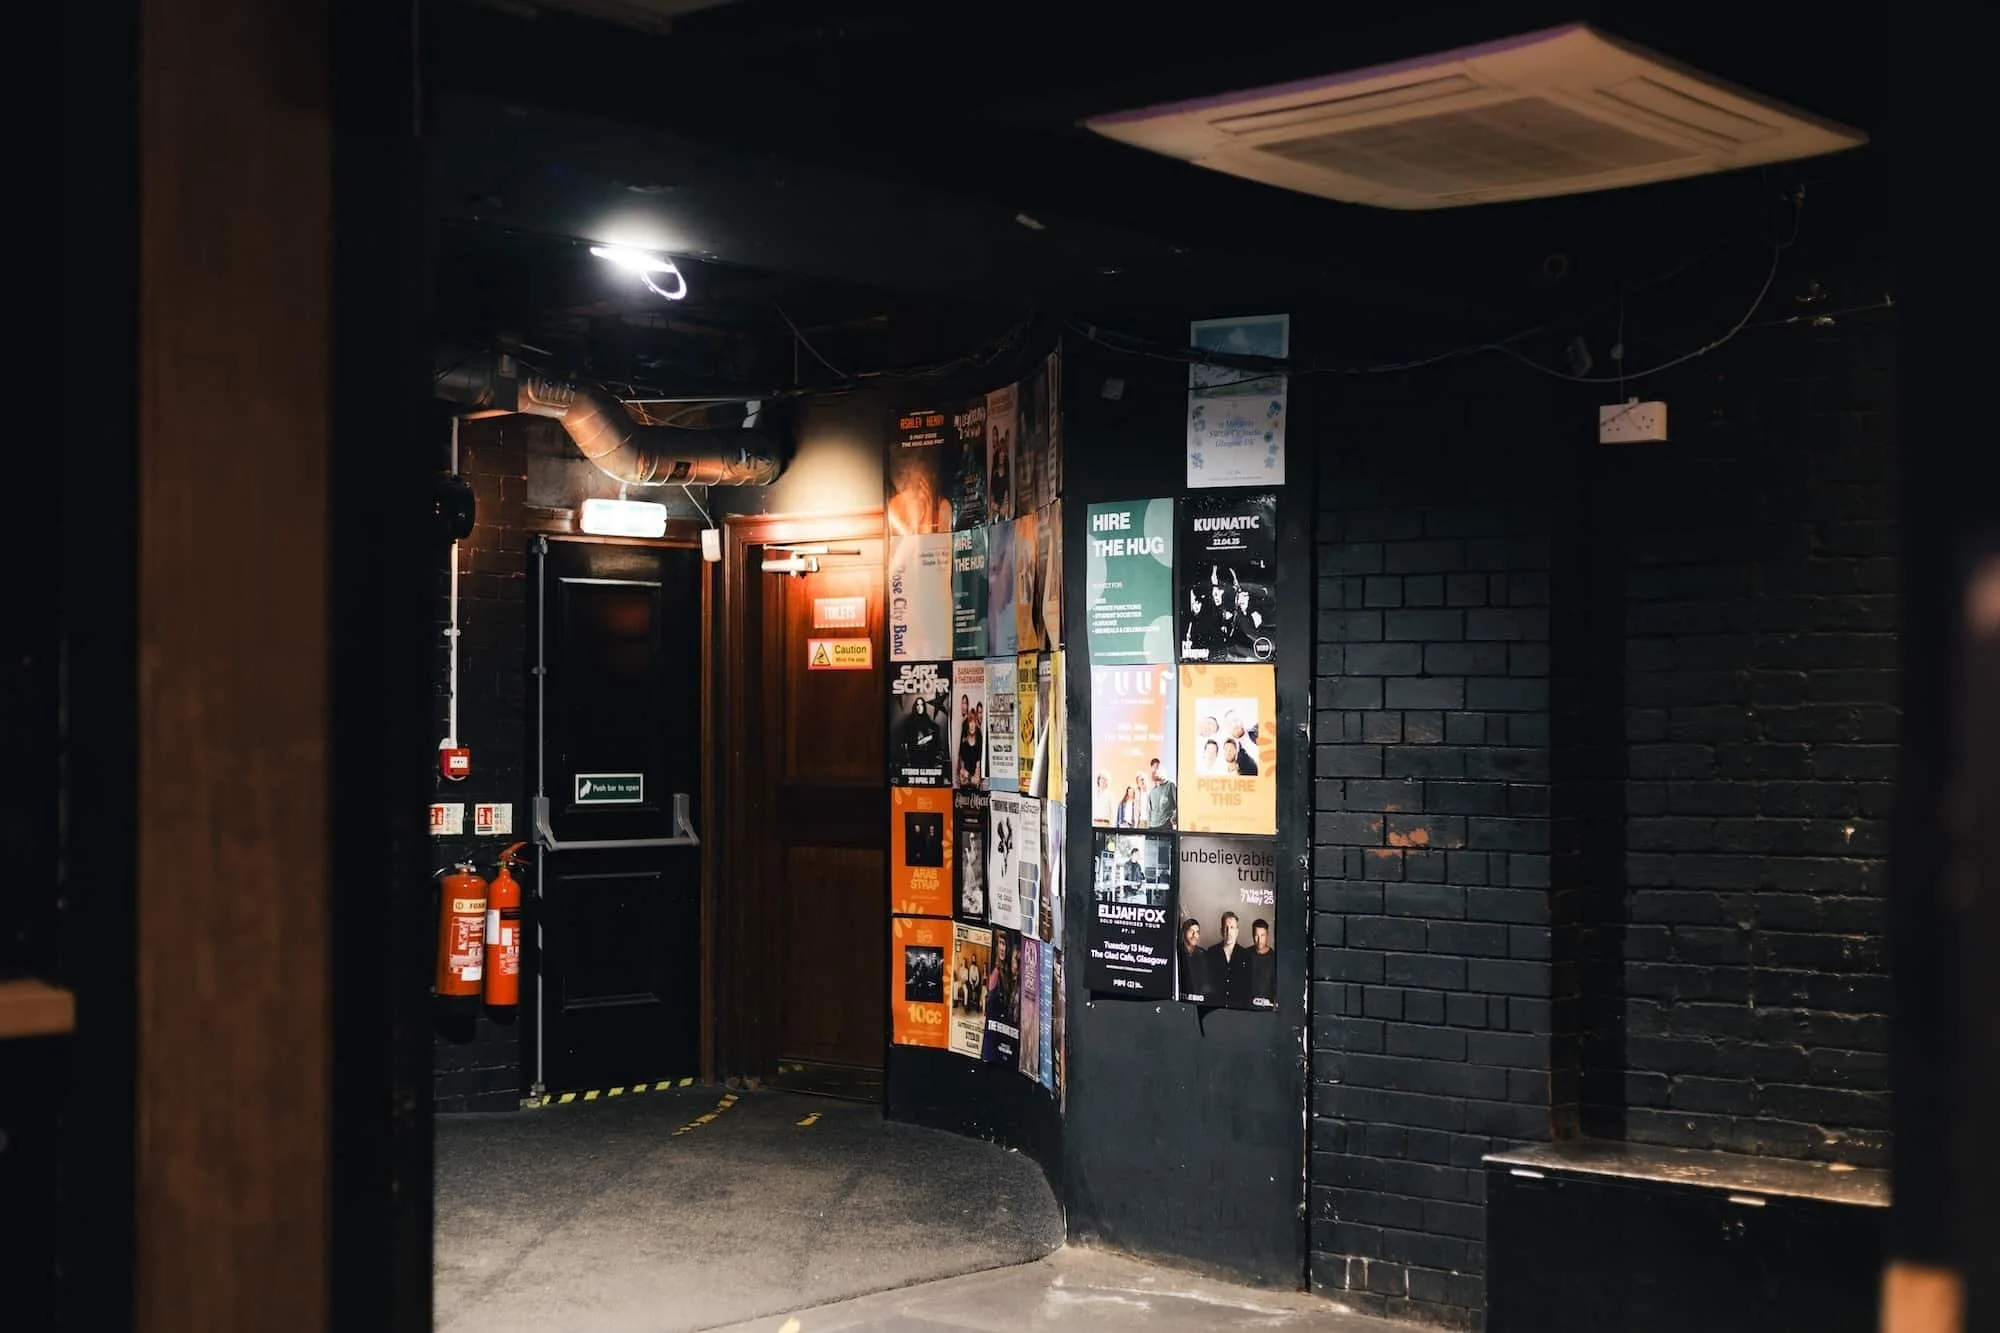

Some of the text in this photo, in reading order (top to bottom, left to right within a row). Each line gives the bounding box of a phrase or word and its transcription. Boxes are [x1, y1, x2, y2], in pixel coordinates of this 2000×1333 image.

[900, 415, 944, 430] ASHLEY HENRY
[1093, 512, 1130, 532] HIRE
[1193, 516, 1260, 532] KUUNATIC
[1093, 536, 1164, 558] THE HUG
[1212, 538, 1240, 546] 22.04.25
[955, 558, 971, 573] THE
[970, 555, 984, 570] HUG
[824, 606, 856, 620] TOILETS
[894, 624, 907, 656] Band
[834, 644, 867, 654] Caution
[900, 664, 938, 680] SARI
[892, 678, 950, 695] SCHORR
[593, 784, 606, 792] Push
[1198, 778, 1256, 792] PICTURE
[1210, 793, 1241, 806] THIS
[1181, 849, 1274, 867] unbelievable
[912, 869, 938, 880] ARAB
[1238, 867, 1274, 882] truth
[910, 878, 940, 891] STRAP
[1240, 894, 1274, 906] 7 May 25
[1098, 903, 1166, 923] ELIJAH FOX
[1104, 941, 1130, 953] Tuesday
[1138, 944, 1154, 955] May
[1091, 949, 1103, 958] The
[1104, 951, 1119, 960] Glad
[1136, 955, 1169, 966] Glasgow
[908, 1003, 943, 1025] 10cc
